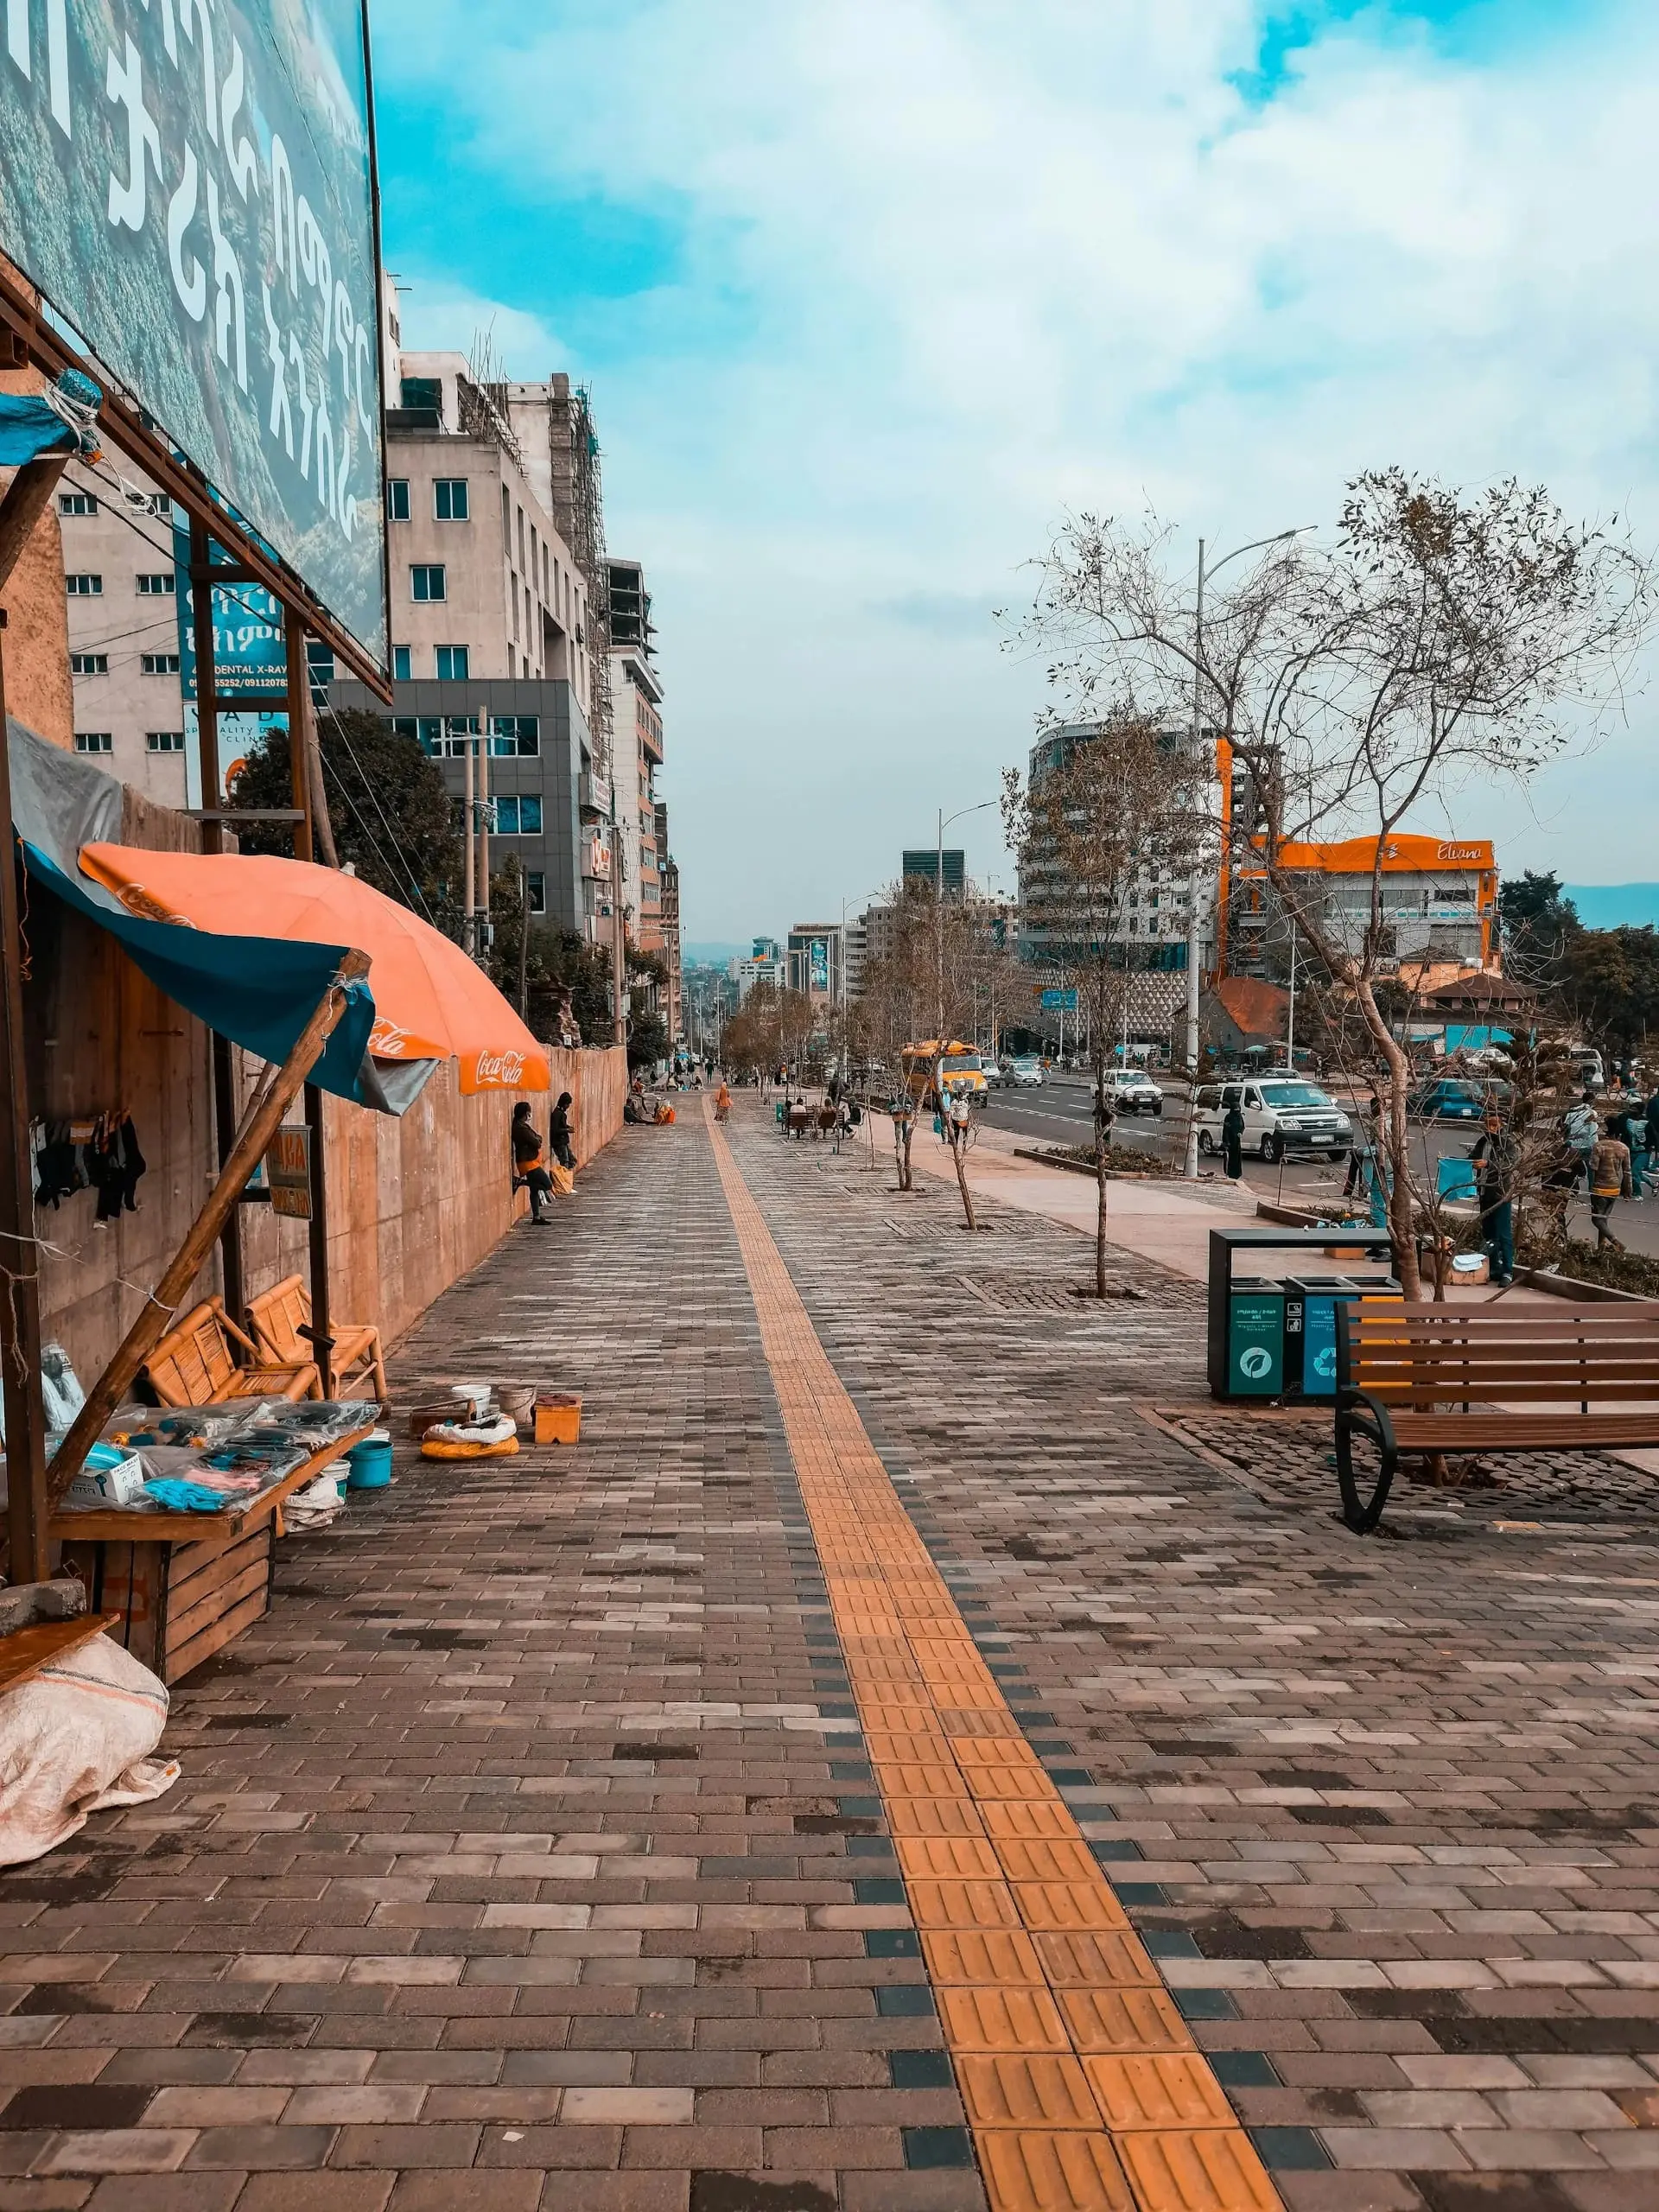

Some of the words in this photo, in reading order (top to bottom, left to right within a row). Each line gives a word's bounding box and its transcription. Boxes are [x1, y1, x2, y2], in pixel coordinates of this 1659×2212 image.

[106, 31, 248, 396] ታሪክ
[263, 281, 358, 543] እንስራ
[271, 133, 373, 451] በማኖር
[214, 664, 254, 675] DENTAL
[257, 664, 288, 674] X-RAY
[185, 726, 253, 735] SPALITY
[1437, 842, 1483, 860] Eliana
